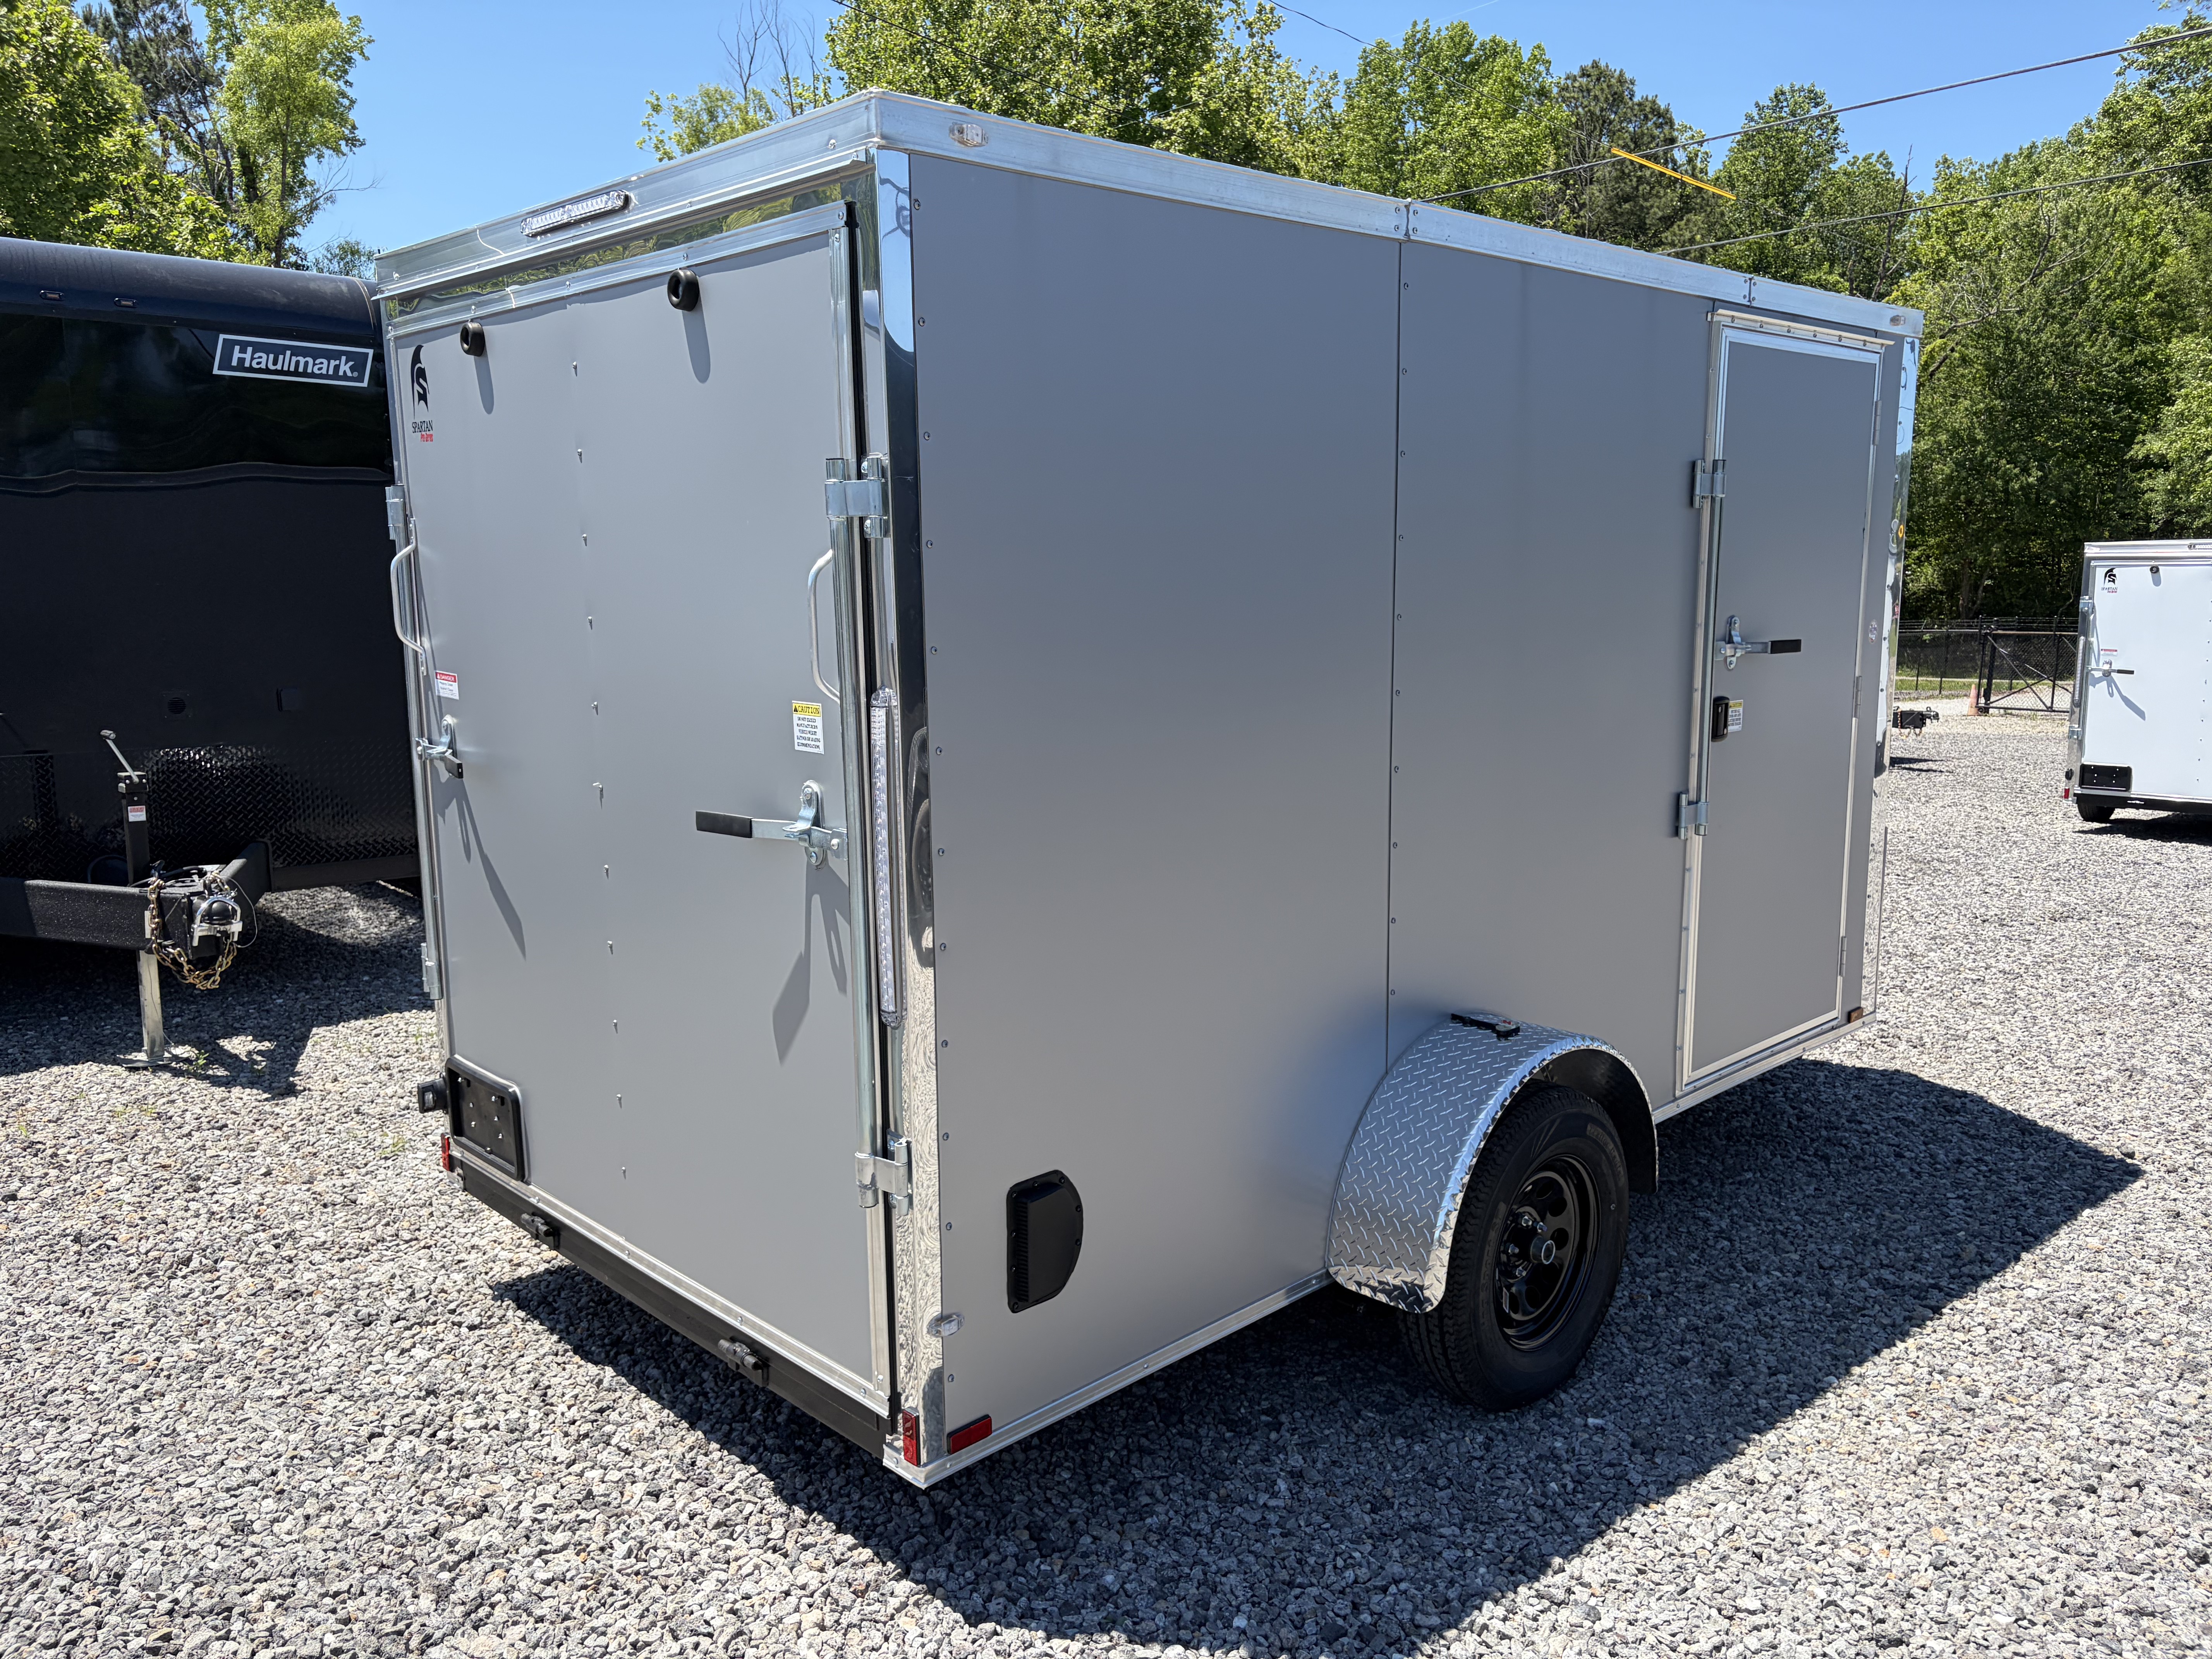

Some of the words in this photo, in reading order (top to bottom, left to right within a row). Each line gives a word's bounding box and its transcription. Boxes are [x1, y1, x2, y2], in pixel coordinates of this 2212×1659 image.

[231, 345, 354, 377] Haulmark
[412, 420, 433, 433] SPARTAN
[798, 705, 819, 714] CAUTION
